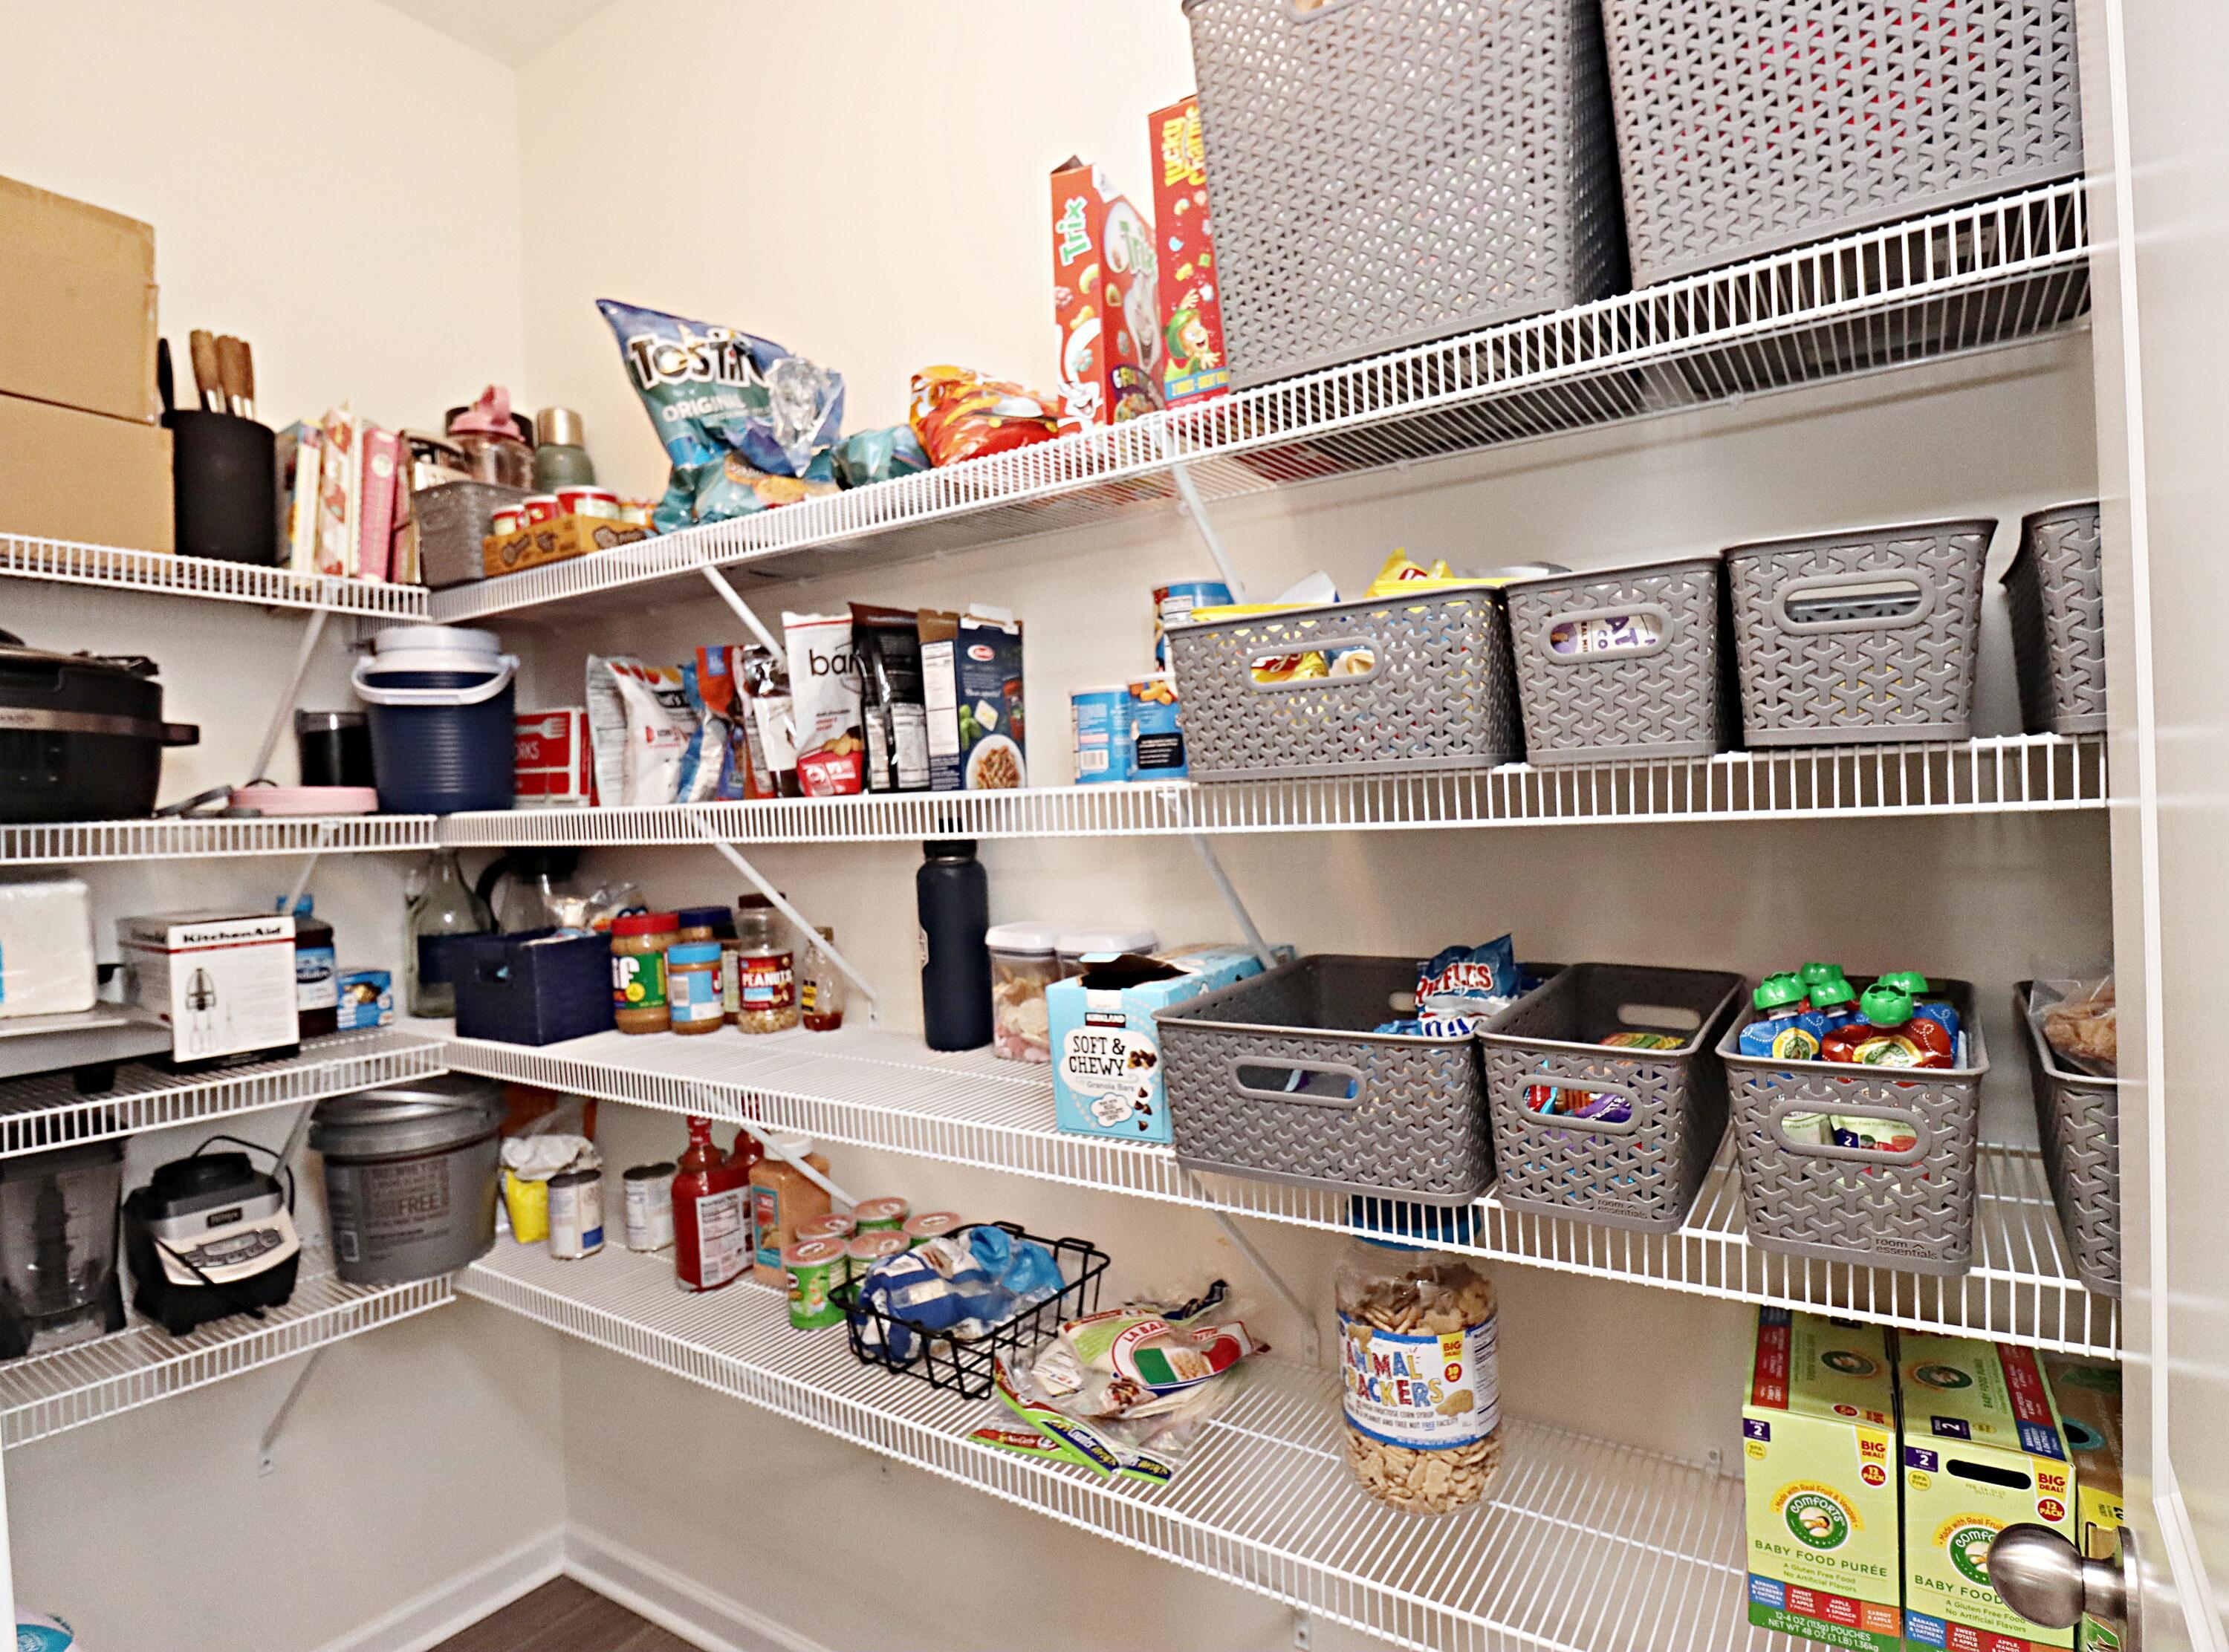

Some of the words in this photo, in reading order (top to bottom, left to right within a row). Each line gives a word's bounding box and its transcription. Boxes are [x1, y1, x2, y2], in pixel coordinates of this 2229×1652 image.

[1057, 196, 1092, 266] Trix
[183, 926, 282, 943] KitchenAid
[1073, 1035, 1108, 1055] SOFT
[1112, 1038, 1126, 1056] &
[1069, 1056, 1125, 1076] CHEWY
[1087, 1081, 1115, 1090] Granola
[1117, 1083, 1135, 1092] Bars
[1843, 1136, 1852, 1147] 2
[400, 1194, 441, 1215] FREE
[1598, 1200, 1623, 1209] room
[1876, 1238, 1908, 1248] room
[1877, 1246, 1938, 1261] essentials
[1124, 1331, 1139, 1342] LA
[1444, 1341, 1462, 1351] BIG
[1347, 1340, 1423, 1380] ANIMAL
[1416, 1411, 1435, 1420] SYRUP
[1422, 1420, 1435, 1429] FREE
[1941, 1422, 1961, 1431] 2
[1753, 1425, 1762, 1436] 2
[1860, 1440, 1886, 1452] BIG
[1862, 1451, 1884, 1459] DEAL!
[1915, 1448, 1933, 1457] STAGE
[1919, 1454, 1929, 1466] 2
[1868, 1466, 1879, 1475] 12
[1863, 1473, 1885, 1483] PACK
[1912, 1474, 1927, 1482] BPA
[2038, 1472, 2066, 1486] BIG
[1787, 1486, 1799, 1495] with
[1816, 1485, 1833, 1496] Fruit
[2039, 1484, 2064, 1493] DEAL!
[1790, 1496, 1843, 1522] COMFORTS
[2045, 1500, 2057, 1510] 12
[2039, 1507, 2064, 1518] PACK
[1938, 1524, 1953, 1540] Made
[1952, 1518, 1966, 1529] with
[1967, 1516, 1984, 1526] Real
[1985, 1518, 2004, 1531] Fruit
[1755, 1539, 1791, 1555] BABY
[1797, 1549, 1836, 1567] FOOD
[1841, 1559, 1888, 1577] PURÉE
[1791, 1564, 1815, 1575] Gluten
[1817, 1569, 1835, 1579] Free
[1836, 1574, 1856, 1584] Food
[1796, 1573, 1828, 1587] Artificial
[1829, 1581, 1857, 1593] Flavors
[1793, 1588, 1811, 1597] SWEET
[1915, 1574, 1954, 1593] BABY
[1960, 1587, 2003, 1605] FOOD
[1829, 1604, 1852, 1613] MANGO
[1954, 1601, 1981, 1615] Gluten
[1982, 1608, 2002, 1620] Free
[2004, 1613, 2026, 1625] Food
[1912, 1616, 1941, 1629] BANANA,
[1945, 1607, 1957, 1616] No
[1959, 1610, 1994, 1626] Artificial
[1996, 1621, 2027, 1633] Flavors
[1774, 1611, 1791, 1622] 12-4
[1792, 1615, 1806, 1625] OZ
[1806, 1619, 1829, 1633] (113g)
[1831, 1624, 1871, 1642] POUCHES
[1908, 1620, 1944, 1635] BLUEBERRY
[1955, 1627, 1976, 1636] SWEET
[1768, 1618, 1785, 1628] NET
[1786, 1622, 1800, 1632] WT
[1802, 1625, 1812, 1635] 48
[1813, 1629, 1826, 1639] OZ
[1827, 1631, 1836, 1642] (3
[1837, 1633, 1853, 1645] LB)
[1855, 1638, 1879, 1652] 1.36kg
[1915, 1627, 1943, 1640] OATMEAL
[1953, 1632, 1978, 1642] POTATO
[1959, 1639, 1979, 1648] APPLE
[1997, 1639, 2019, 1648] APPLE,
